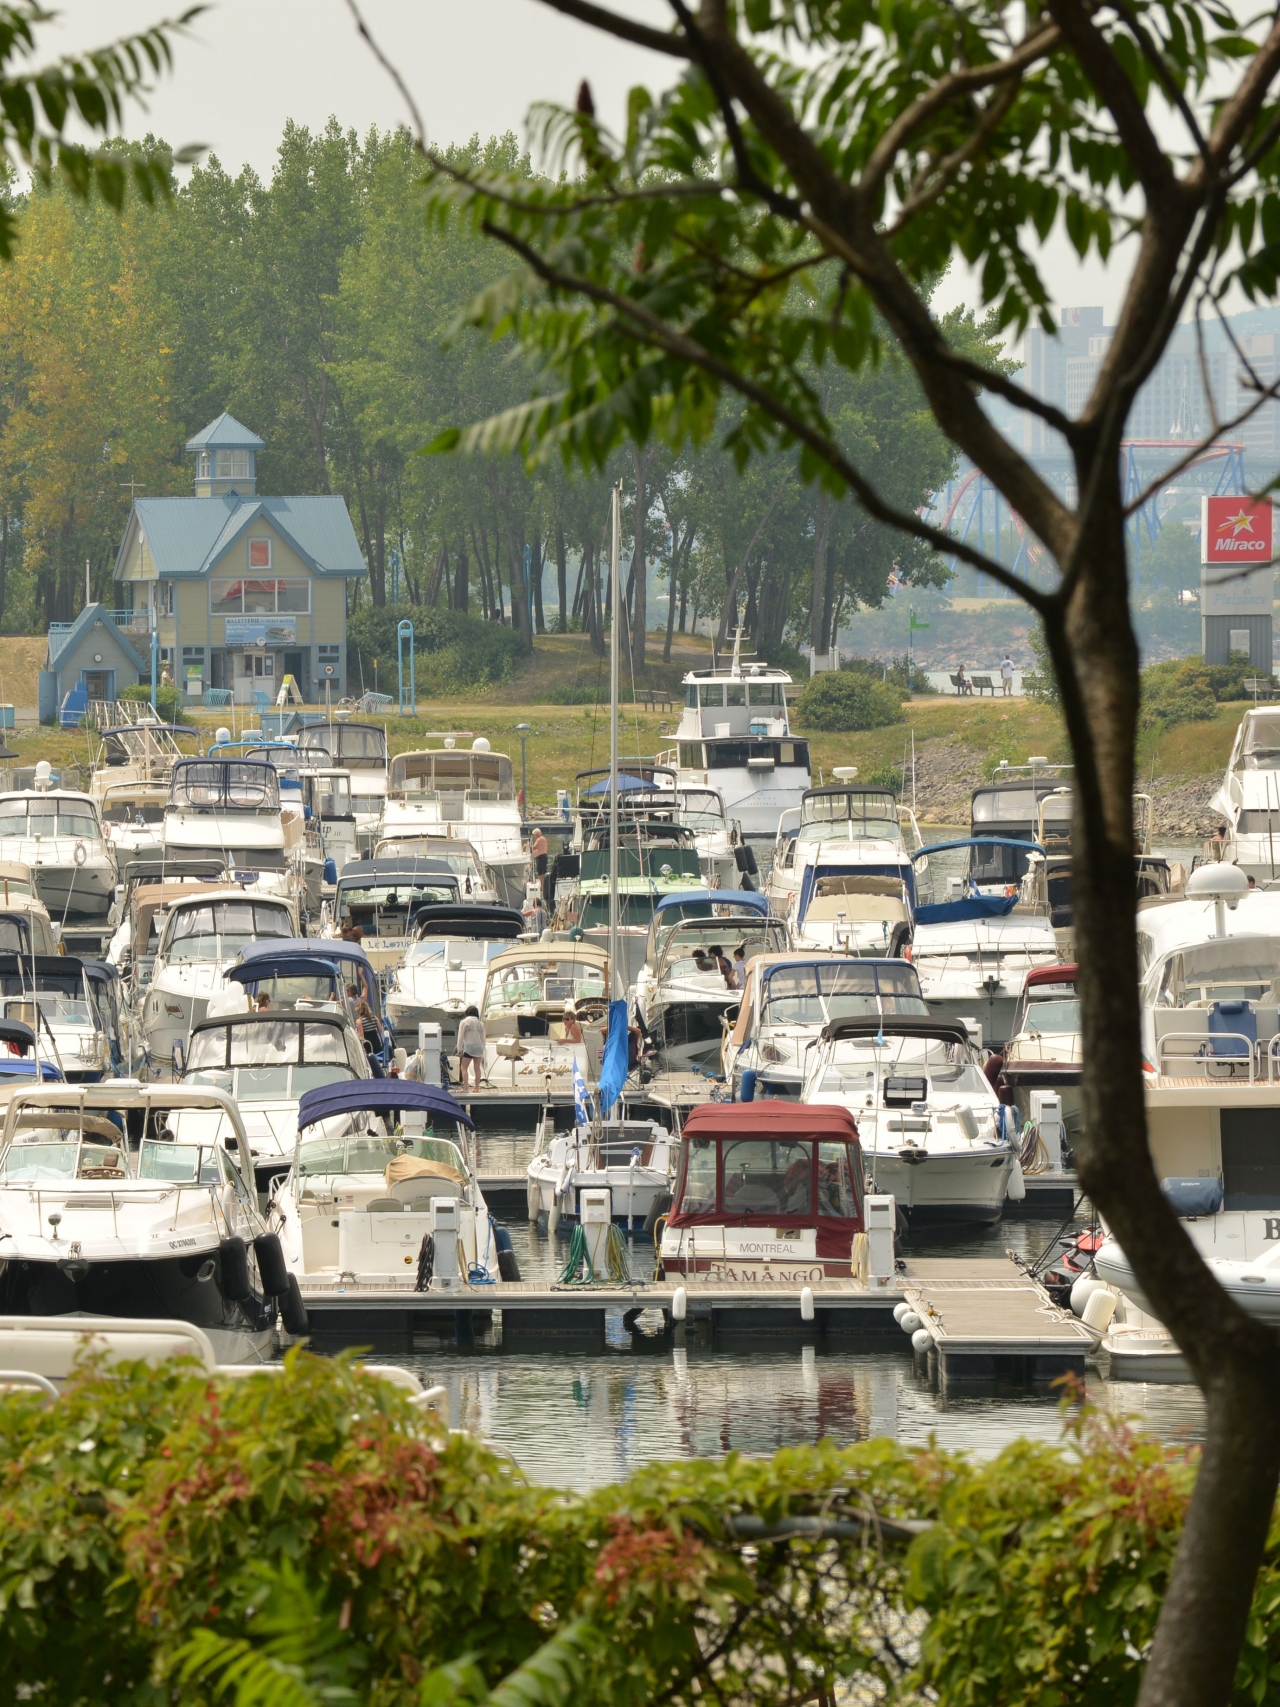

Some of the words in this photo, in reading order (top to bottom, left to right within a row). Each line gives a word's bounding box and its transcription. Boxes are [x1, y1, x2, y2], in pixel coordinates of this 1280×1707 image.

[1214, 538, 1266, 551] Miraco
[1212, 593, 1268, 606] Plaisance
[518, 1065, 534, 1075] Le
[739, 1243, 796, 1254] MONTREAL
